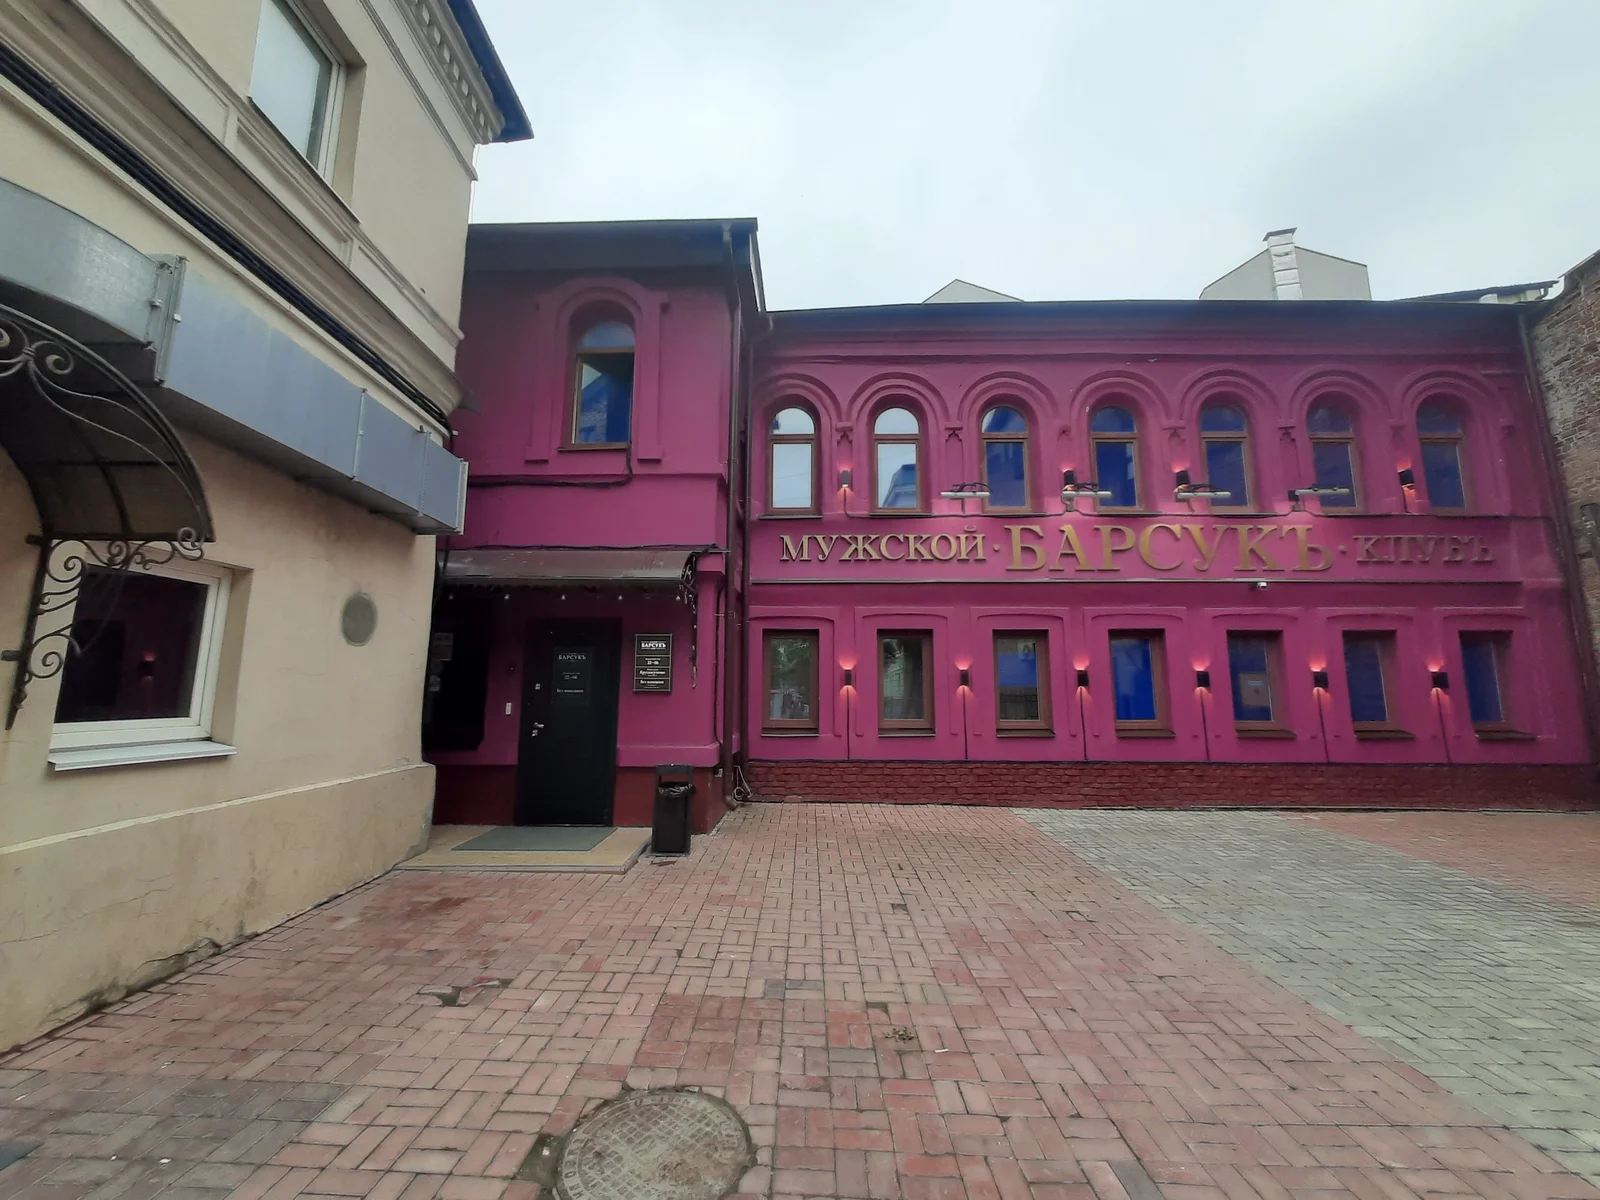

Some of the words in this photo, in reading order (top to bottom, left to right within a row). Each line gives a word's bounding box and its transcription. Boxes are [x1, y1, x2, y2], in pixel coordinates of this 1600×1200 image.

[780, 525, 987, 562] МУЖСКОЙ
[1003, 522, 1333, 572] БАРСУКЪ
[1353, 533, 1496, 565] КЛУБЪ
